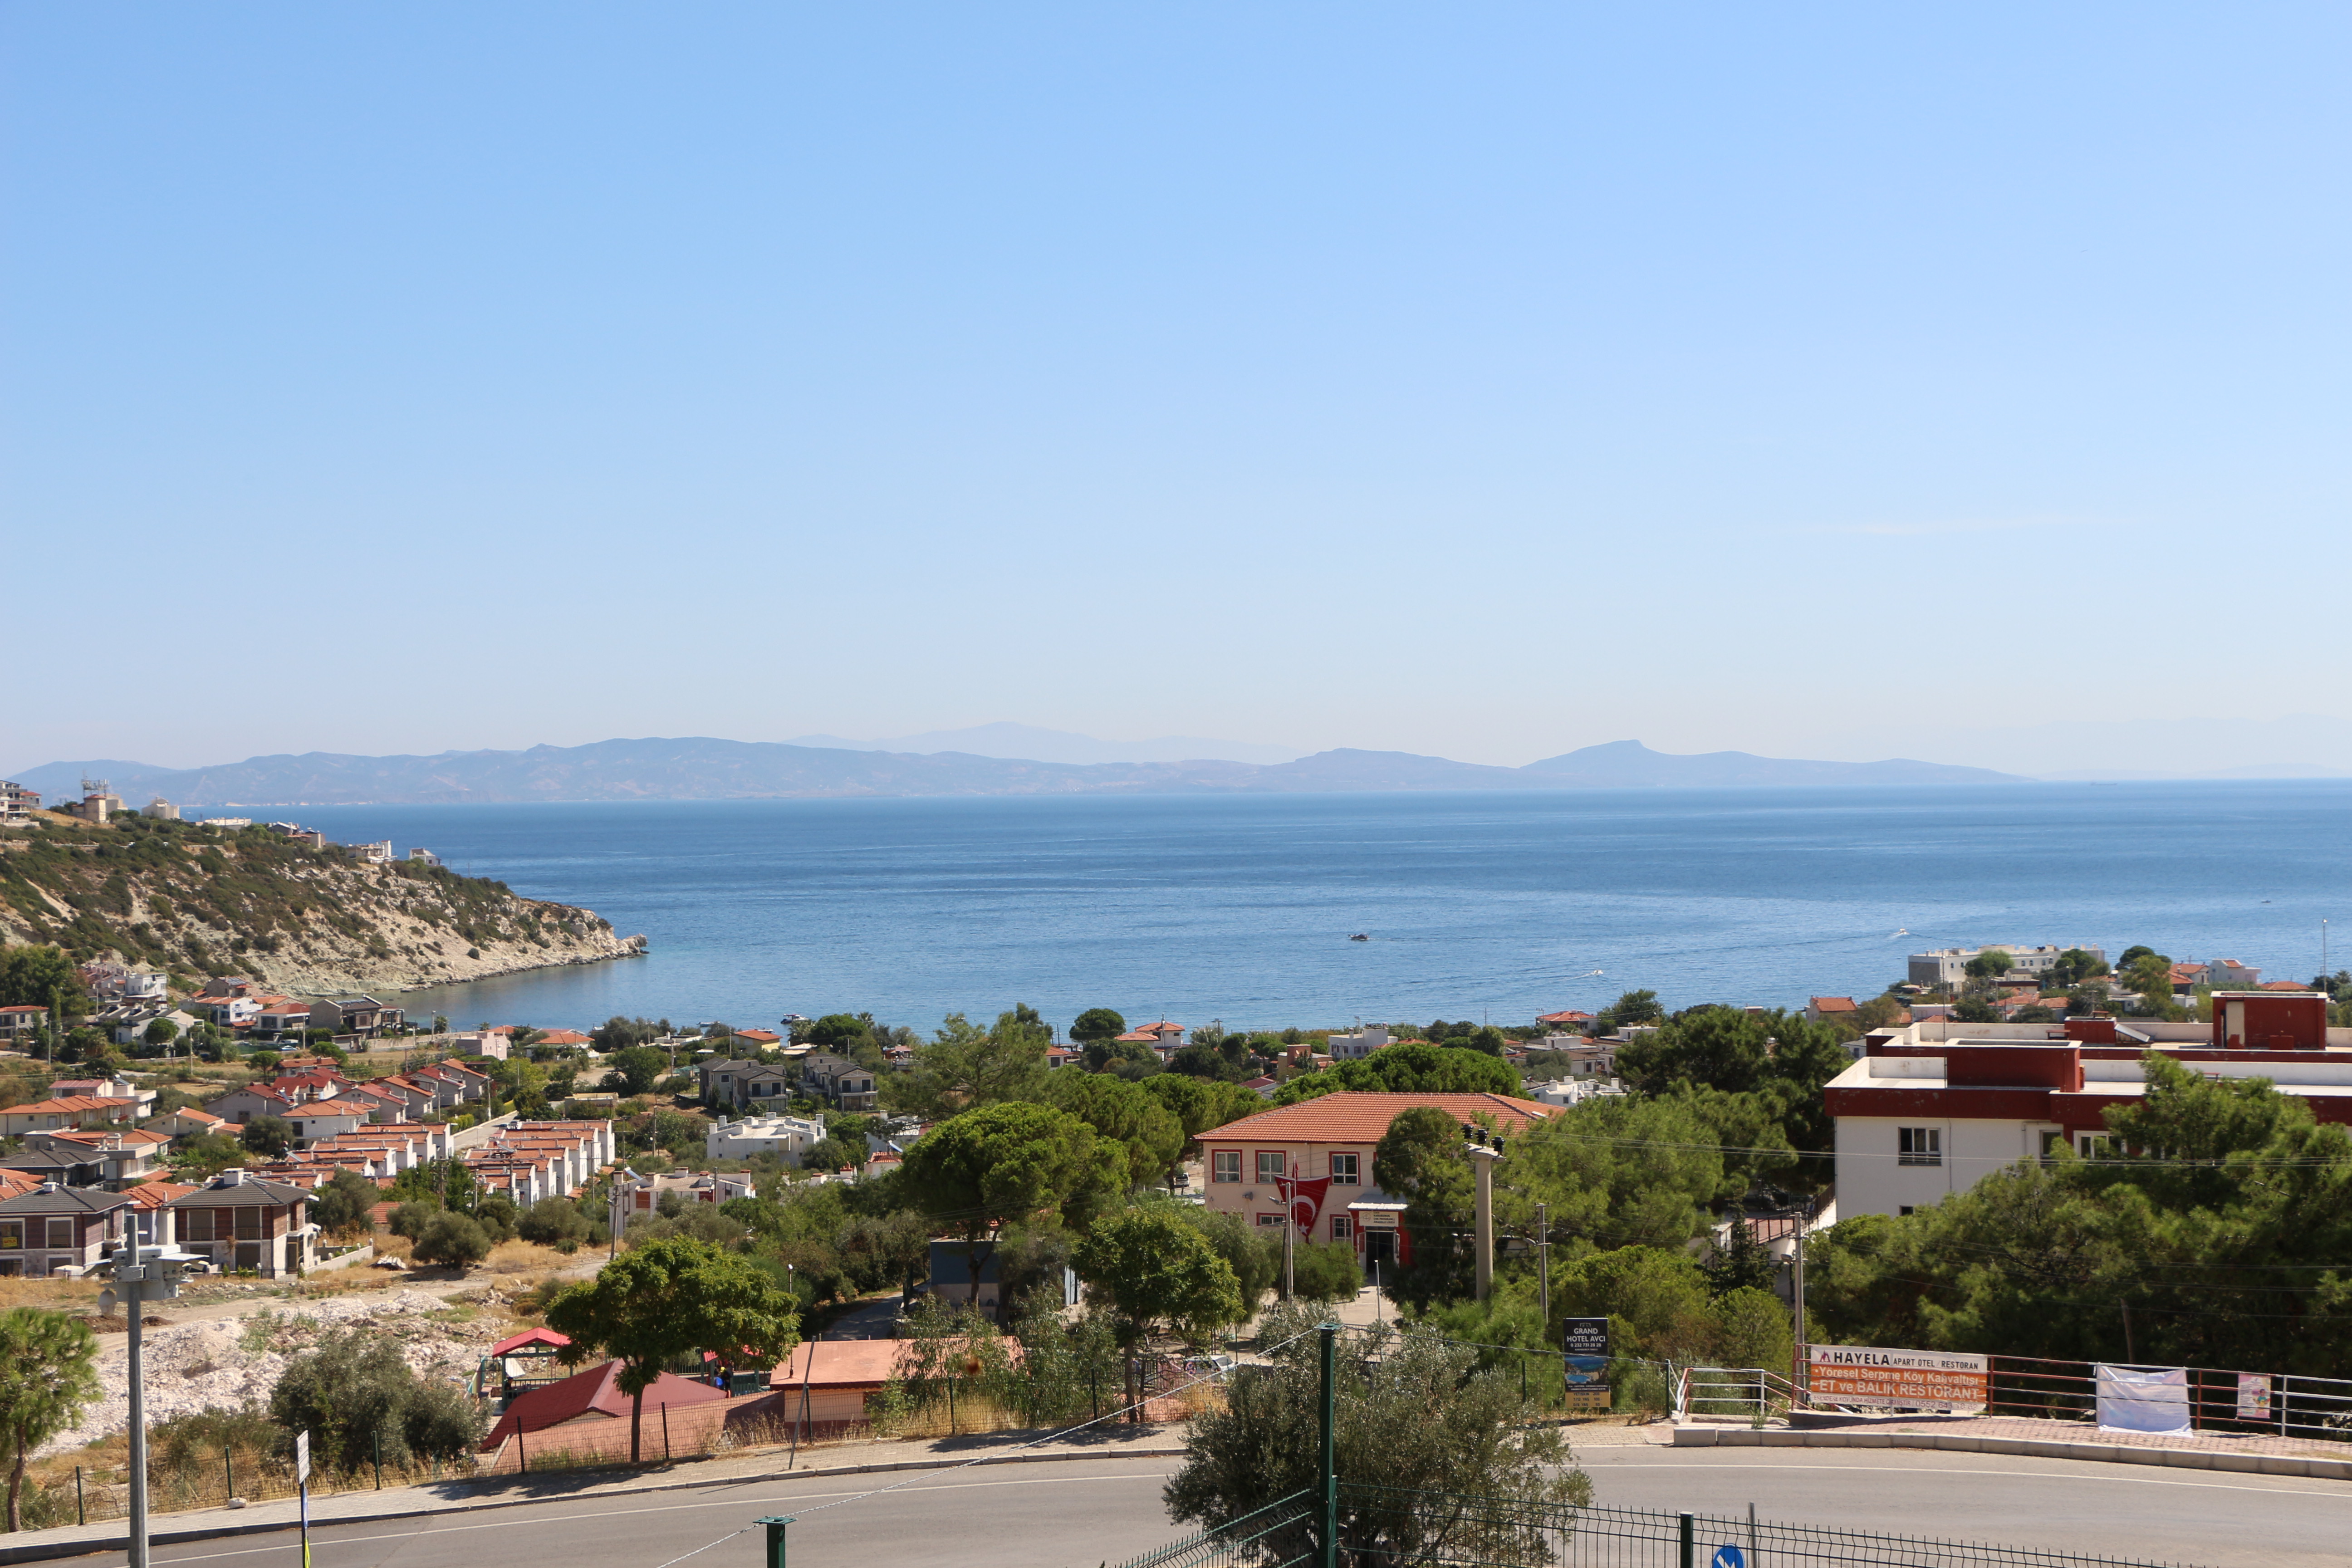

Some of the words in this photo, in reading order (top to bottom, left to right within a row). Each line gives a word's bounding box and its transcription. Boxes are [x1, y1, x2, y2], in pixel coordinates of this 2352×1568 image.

[1834, 1352, 1890, 1365] HAYELA
[1941, 1361, 1979, 1370] RESTORAN
[1819, 1366, 1858, 1378] Yöresel
[1861, 1368, 1900, 1381] Serpme
[1904, 1371, 1924, 1383] Köy
[1820, 1379, 1836, 1391] ET
[1839, 1382, 1853, 1392] ve
[1857, 1381, 1896, 1394] BALIK
[1900, 1384, 1980, 1399] RESTORANT
